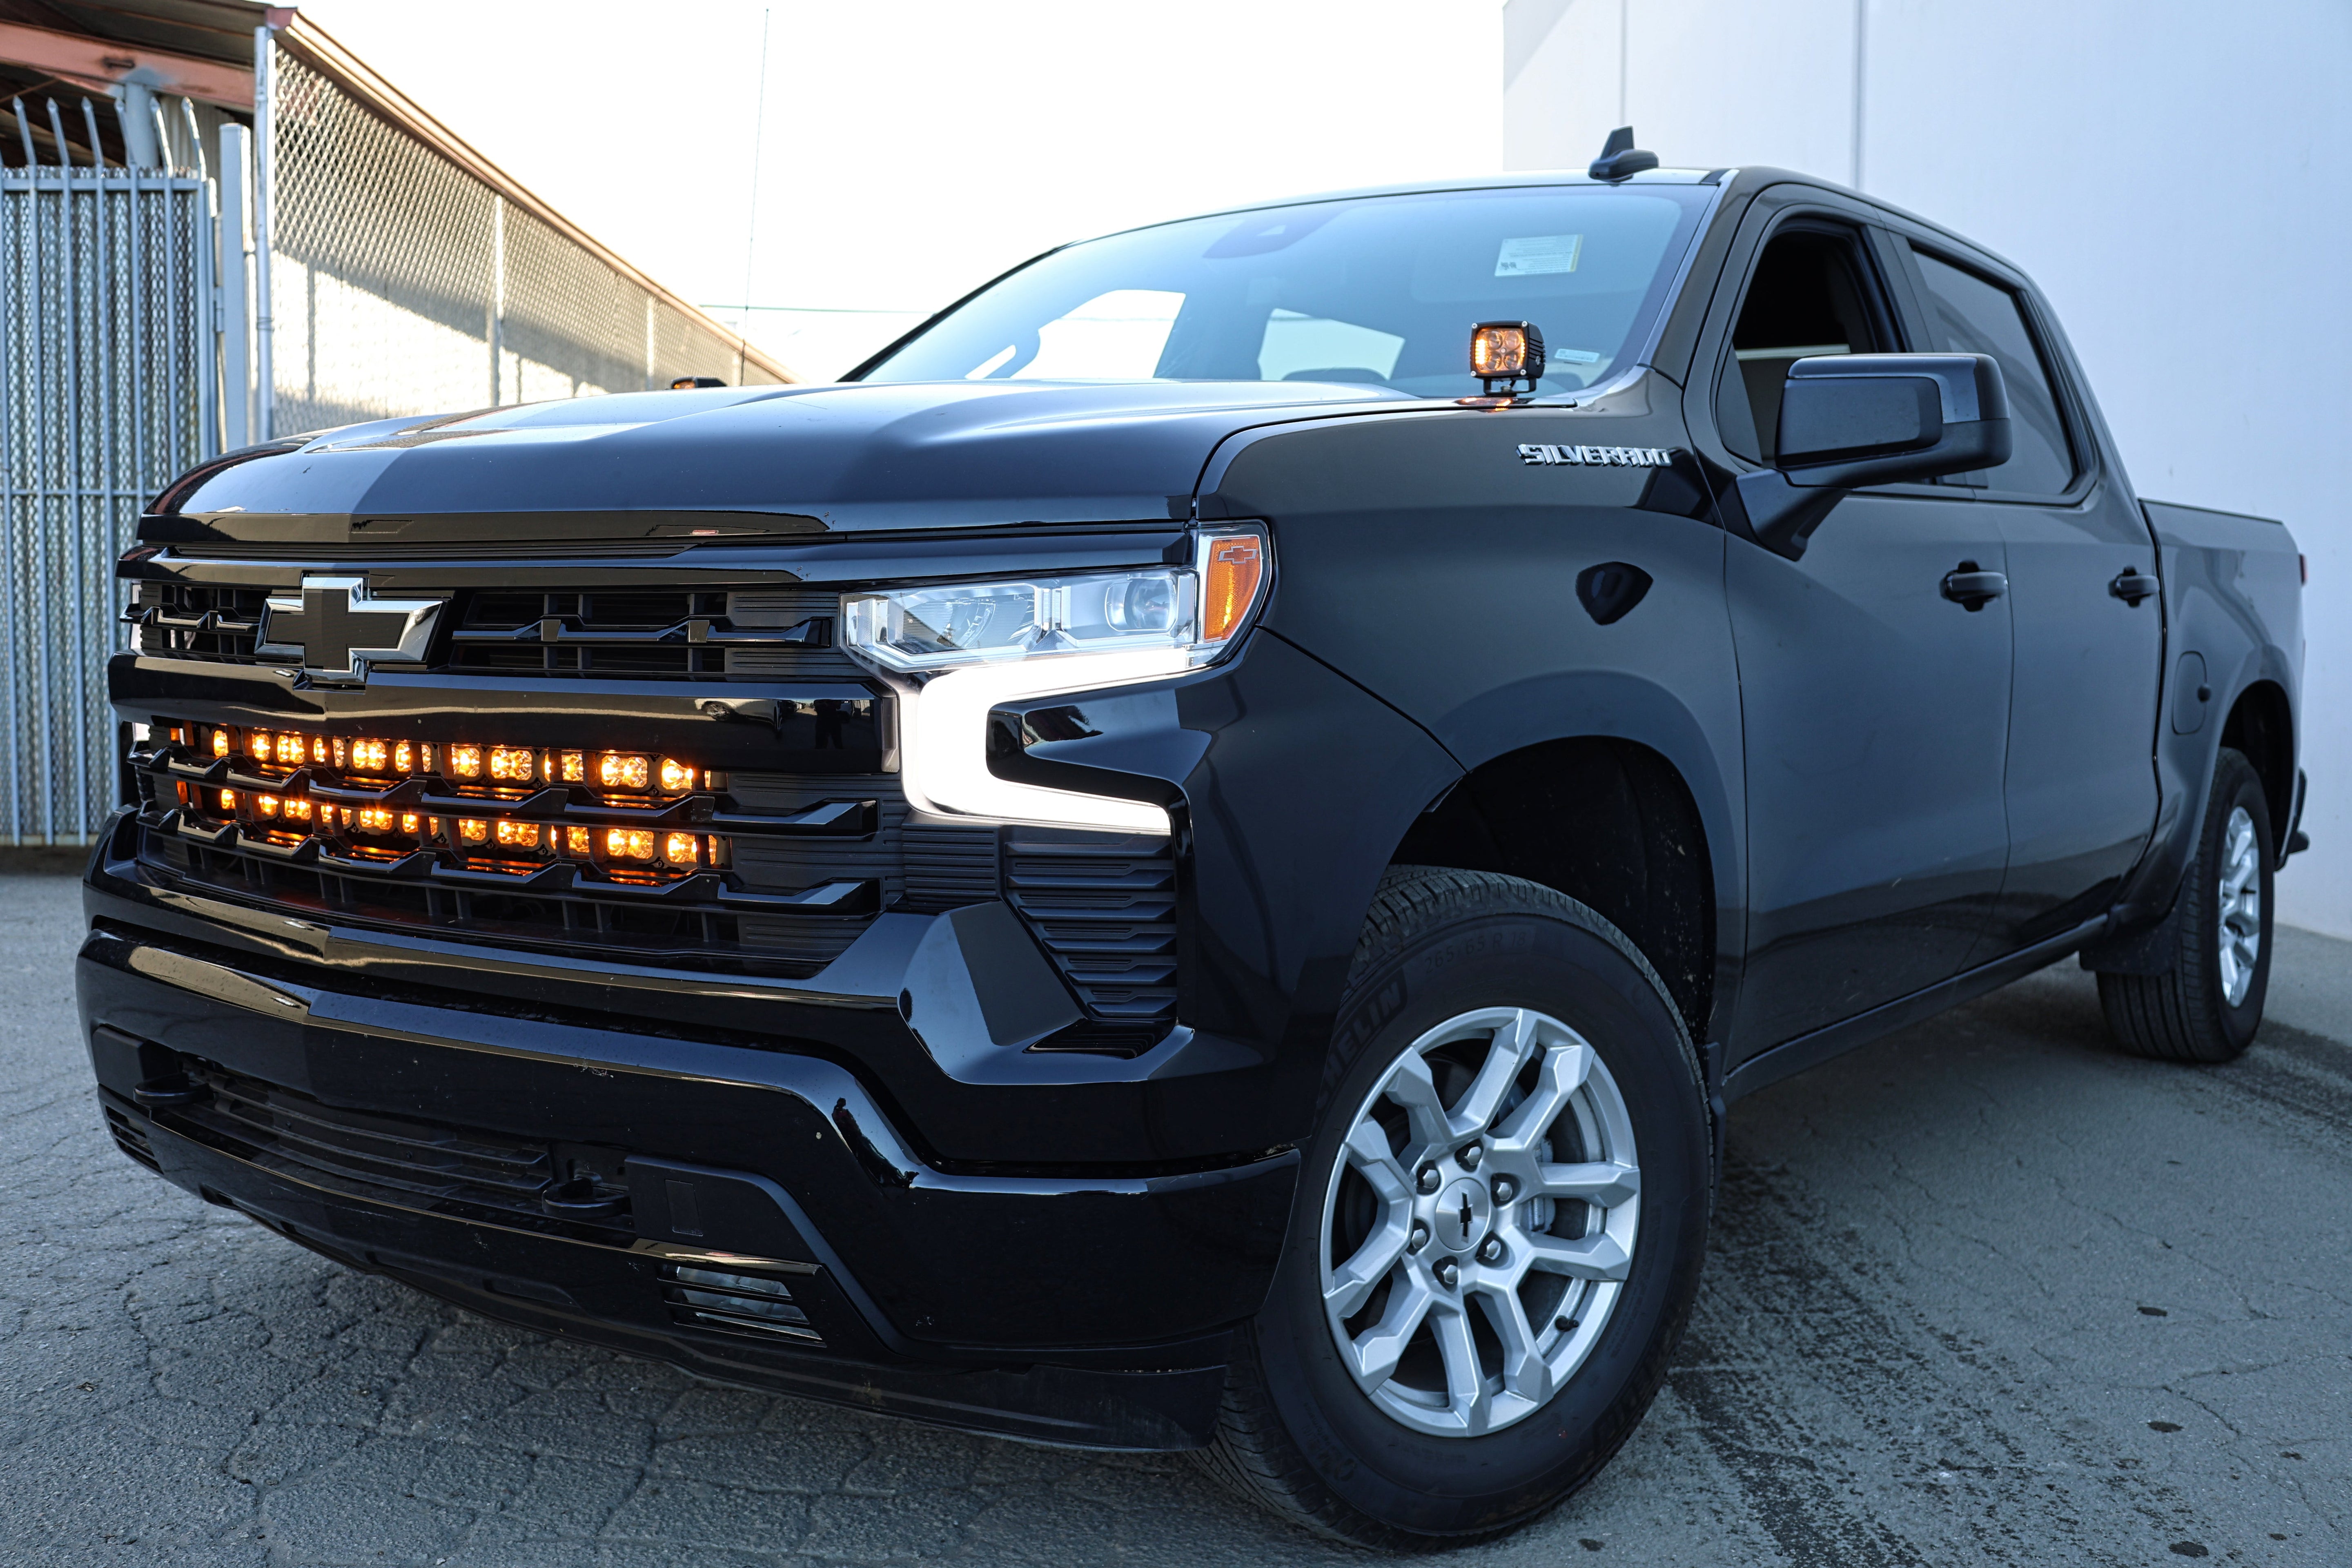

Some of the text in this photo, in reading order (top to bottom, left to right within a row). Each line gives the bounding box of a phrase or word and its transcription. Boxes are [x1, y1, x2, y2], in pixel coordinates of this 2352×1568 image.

[1516, 443, 1672, 467] SILVERADO
[1492, 932, 1503, 949] R
[1511, 931, 1526, 947] 18
[1313, 981, 1401, 1119] HELIN
